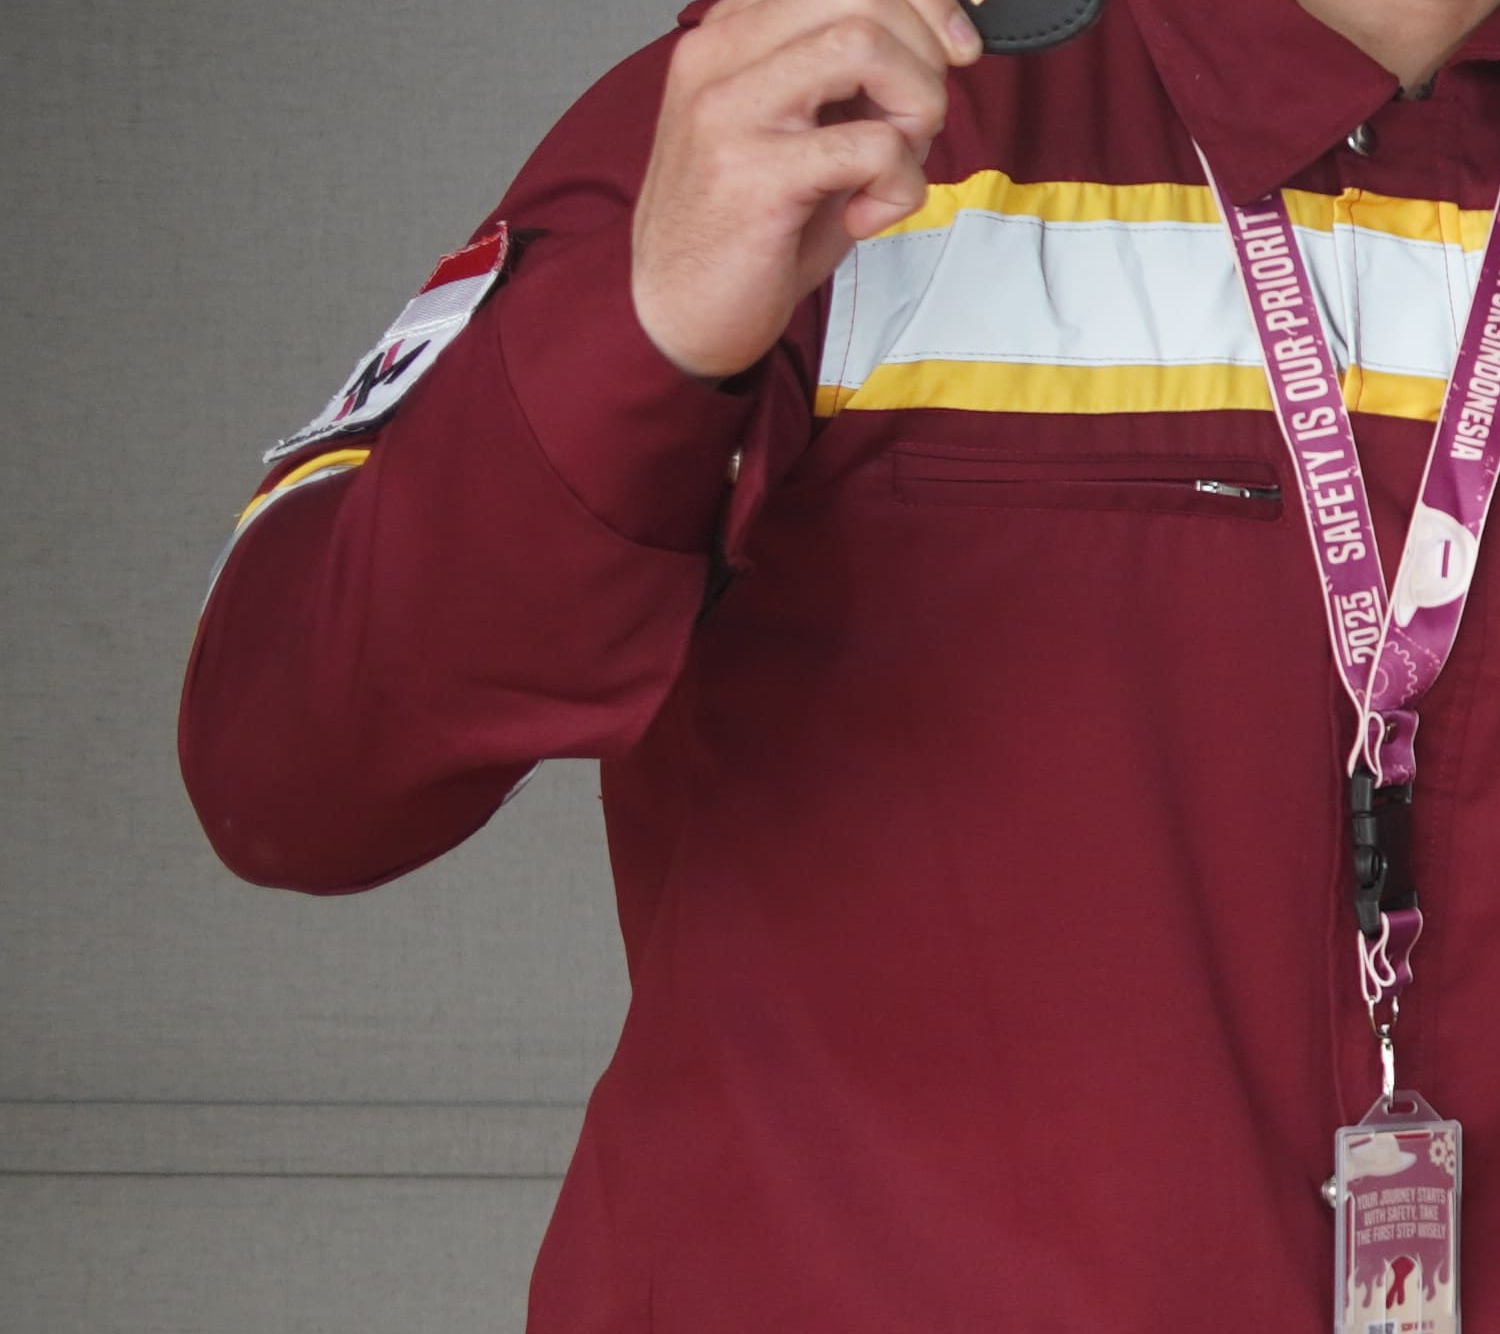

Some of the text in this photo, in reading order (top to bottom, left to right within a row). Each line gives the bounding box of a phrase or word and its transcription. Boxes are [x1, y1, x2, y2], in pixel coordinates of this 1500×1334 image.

[1238, 194, 1366, 565] SAFETY IS OUR PRIORIT
[1351, 592, 1380, 665] 2025
